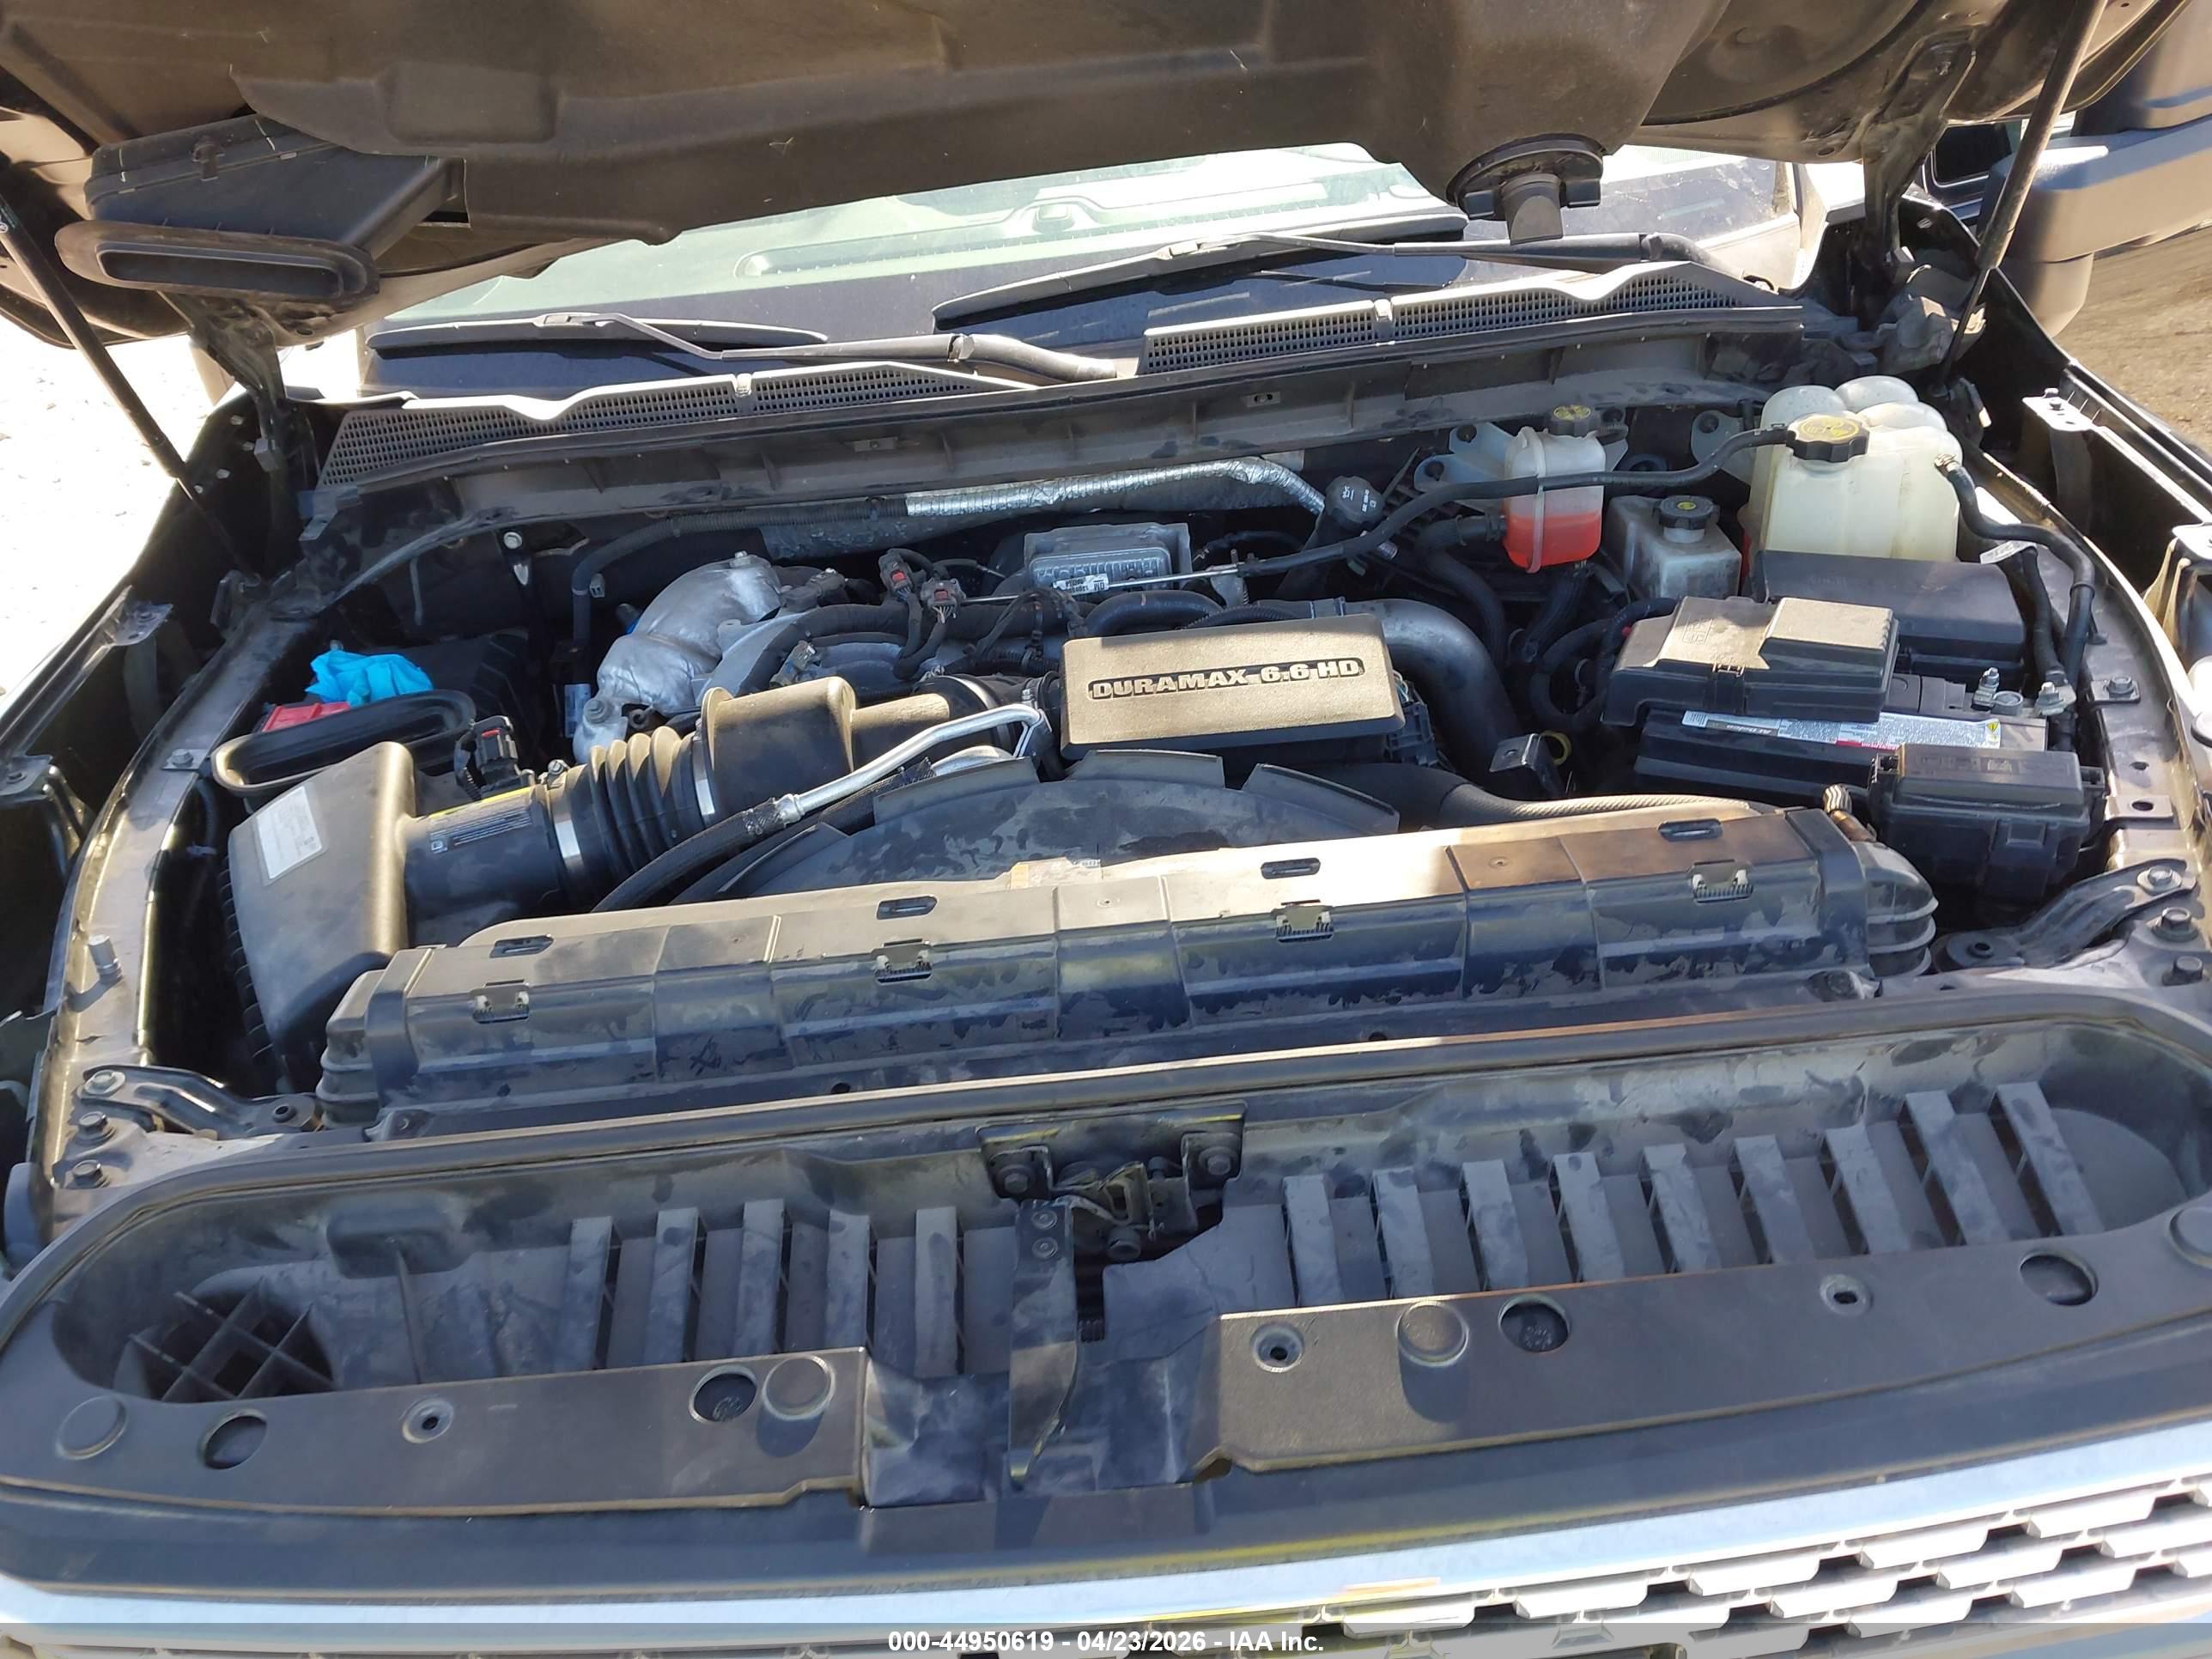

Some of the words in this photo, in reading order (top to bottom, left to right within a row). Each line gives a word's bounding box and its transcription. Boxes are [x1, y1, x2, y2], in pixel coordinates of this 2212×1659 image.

[1091, 668, 1248, 699] DURAMAX
[1261, 665, 1310, 683] 6.6
[1316, 659, 1360, 678] HD
